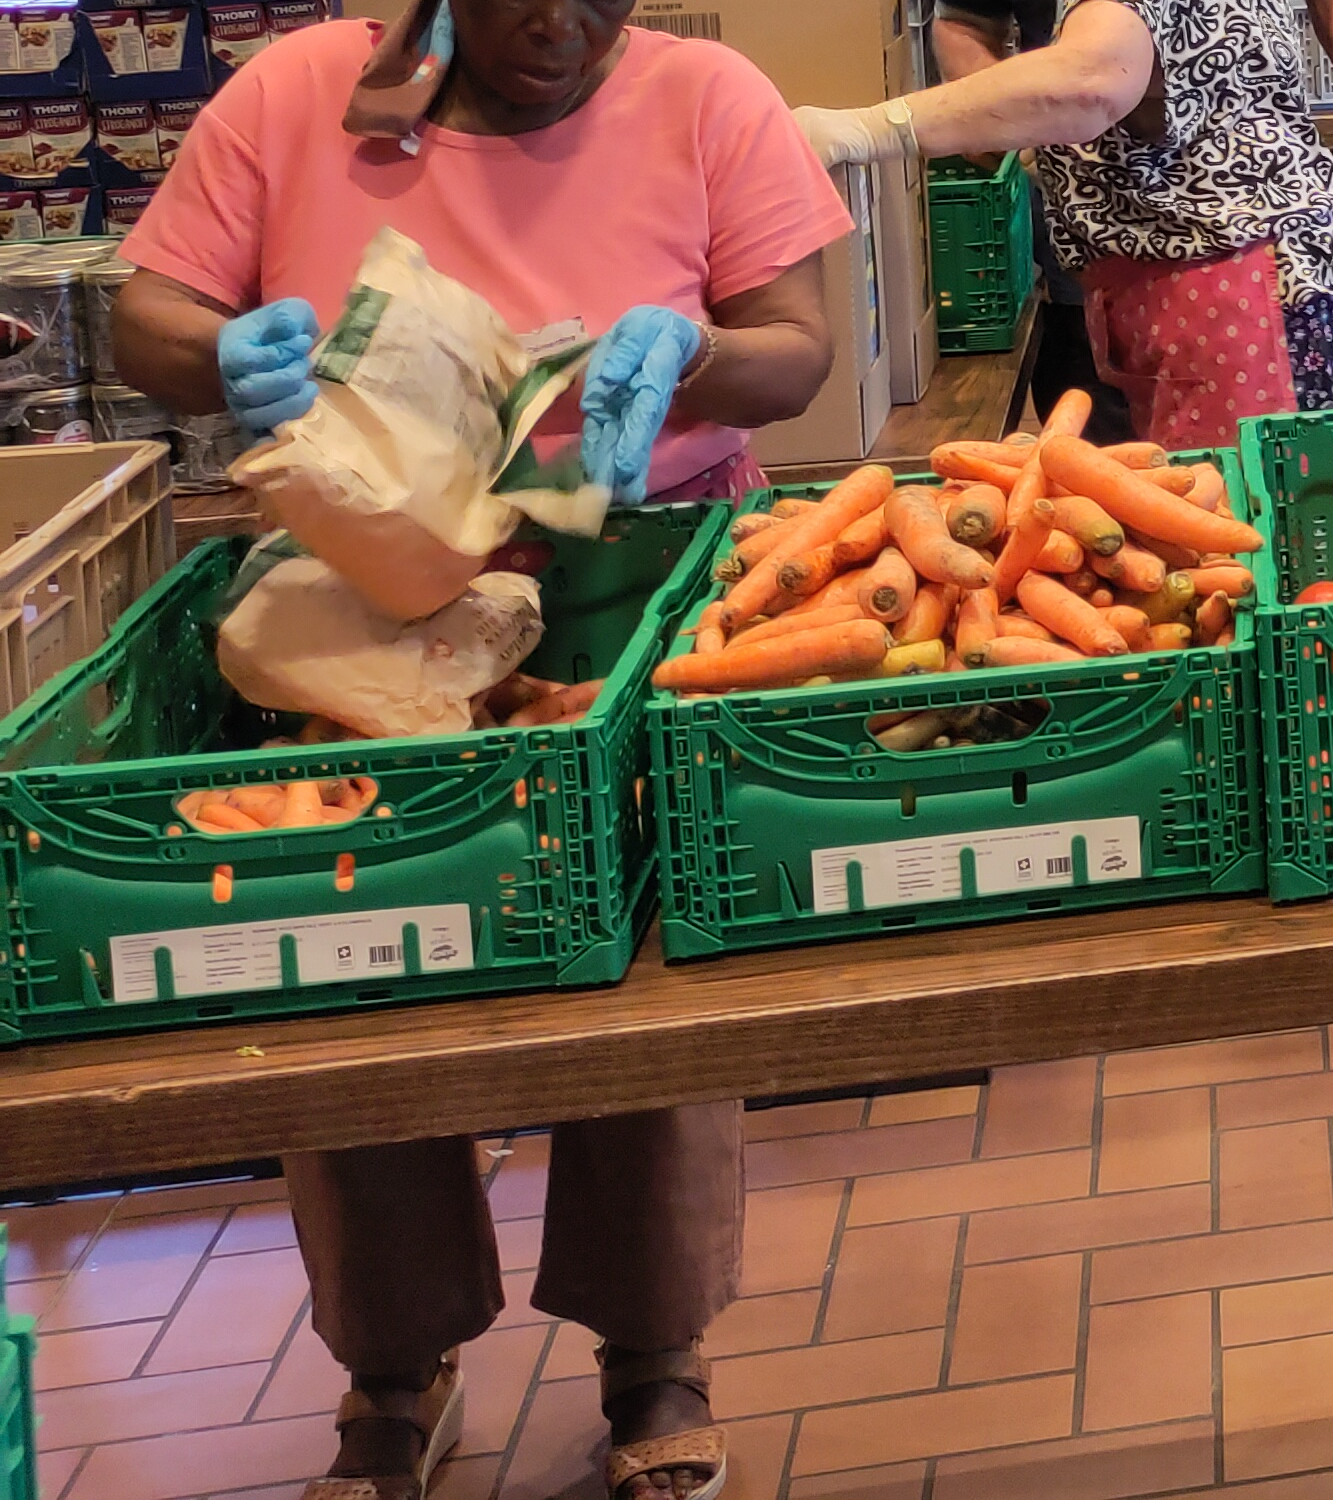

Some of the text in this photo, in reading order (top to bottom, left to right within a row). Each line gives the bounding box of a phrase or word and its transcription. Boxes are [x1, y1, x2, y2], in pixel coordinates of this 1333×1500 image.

[271, 2, 316, 15] THOMY
[212, 9, 257, 22] THOMY
[32, 103, 79, 115] THOMY
[100, 106, 146, 117] THOMY
